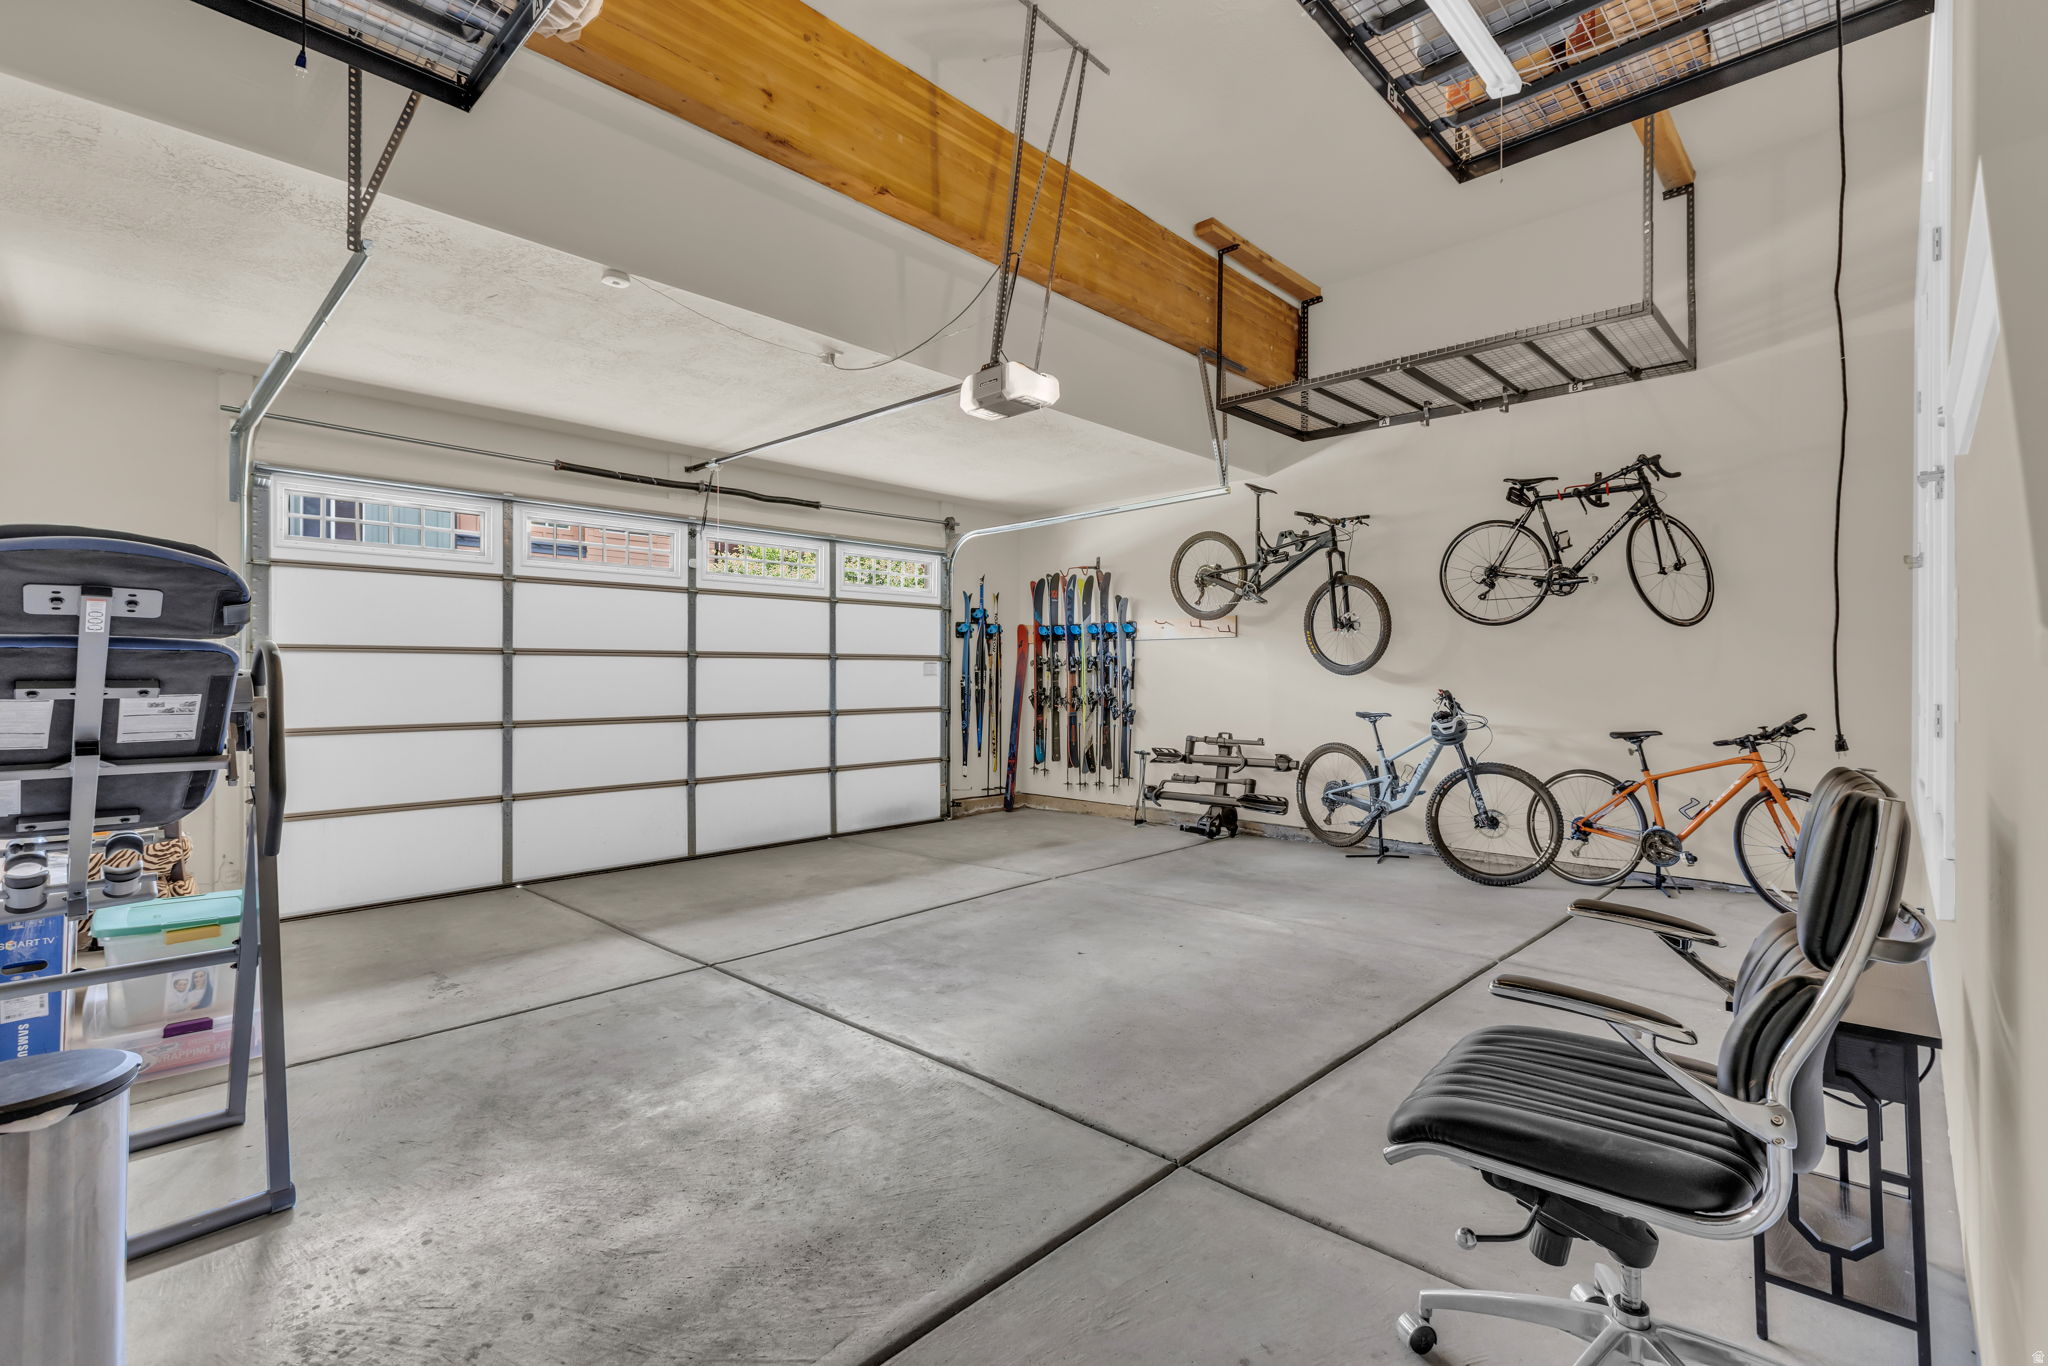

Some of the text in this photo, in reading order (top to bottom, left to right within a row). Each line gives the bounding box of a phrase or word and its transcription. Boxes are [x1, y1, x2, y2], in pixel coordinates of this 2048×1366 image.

[1579, 513, 1630, 567] cannondale
[42, 936, 55, 945] TV
[17, 1023, 30, 1058] SAMSU
